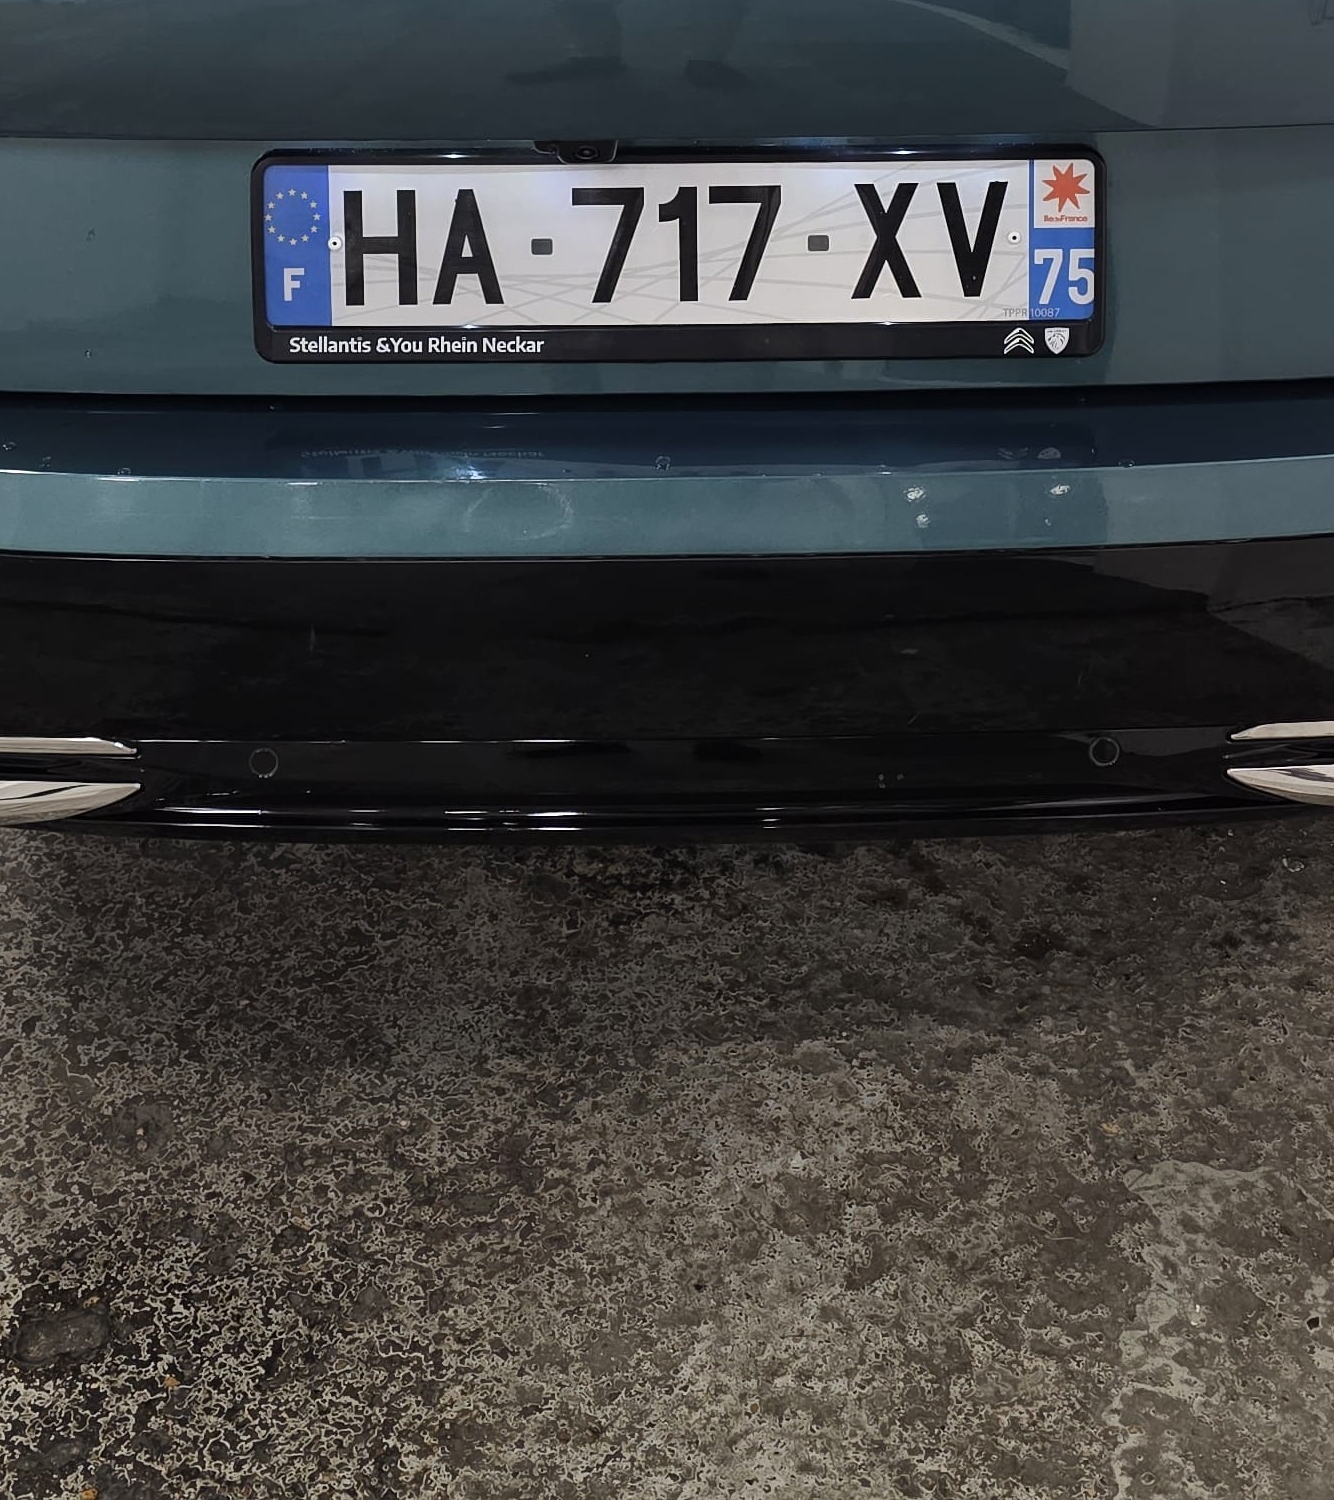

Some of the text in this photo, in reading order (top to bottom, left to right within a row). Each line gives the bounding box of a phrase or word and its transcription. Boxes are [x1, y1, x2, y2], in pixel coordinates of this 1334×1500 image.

[283, 268, 305, 302] F
[1034, 249, 1095, 305] 75
[1030, 308, 1061, 318] 10087
[289, 336, 545, 354] Stellantis &You Rhein Neckar
